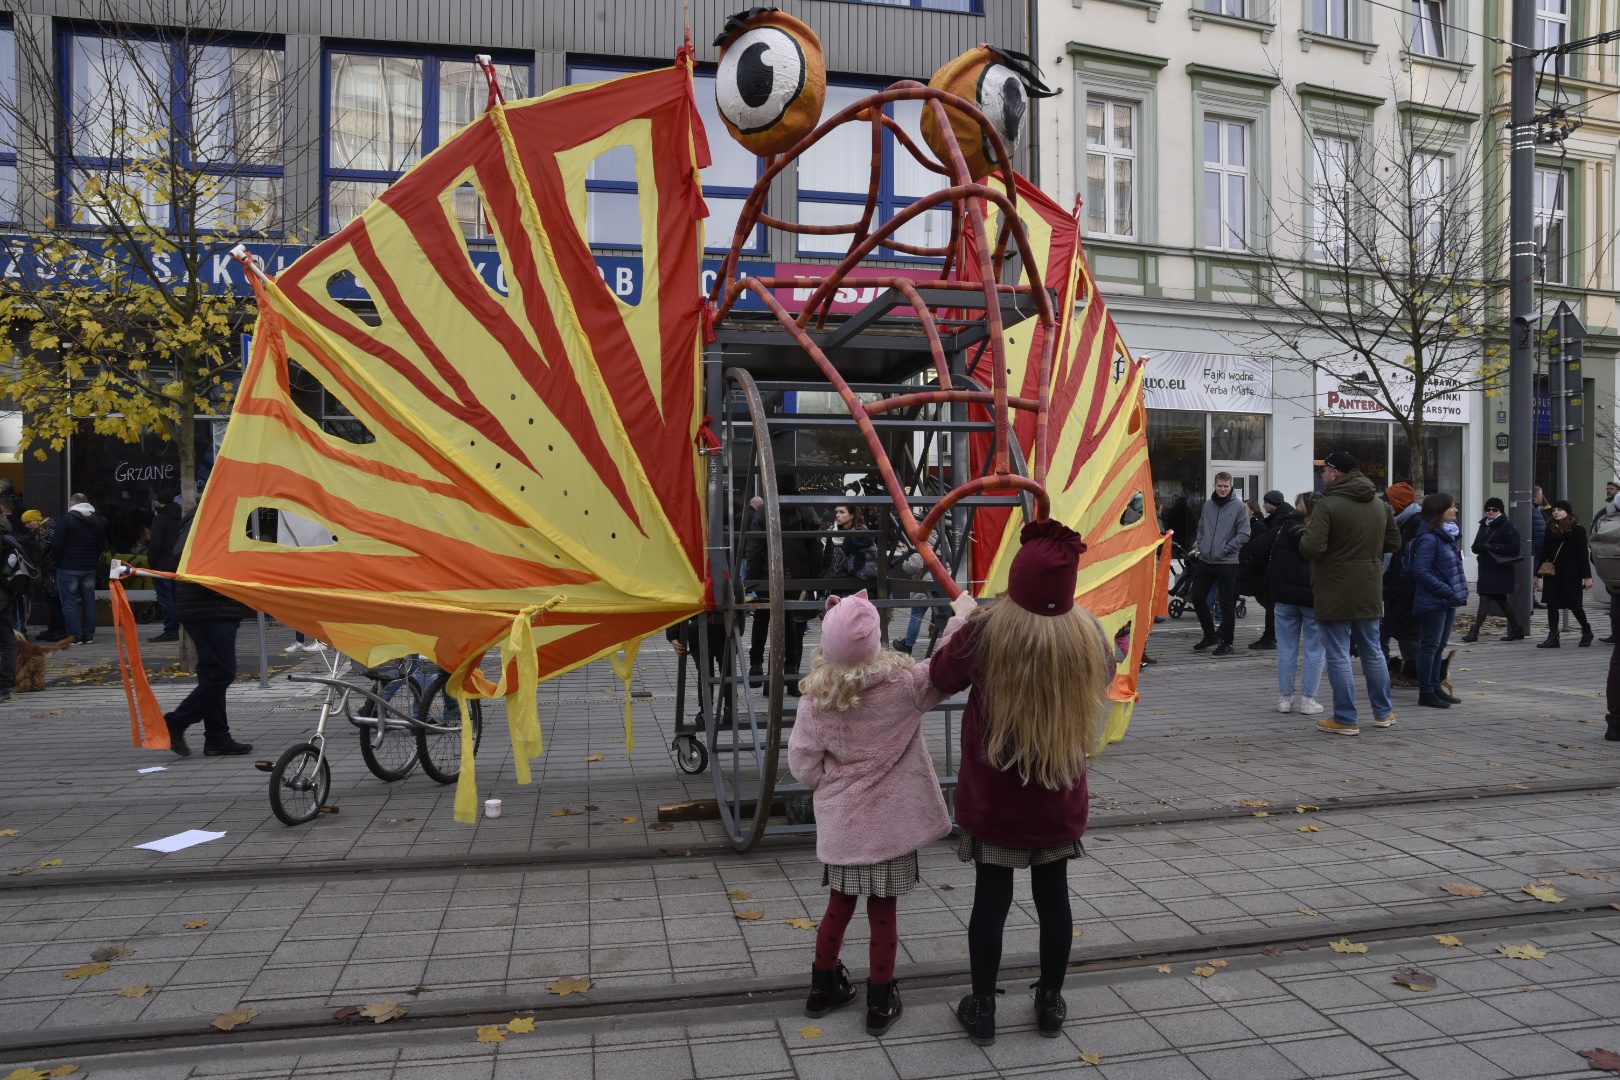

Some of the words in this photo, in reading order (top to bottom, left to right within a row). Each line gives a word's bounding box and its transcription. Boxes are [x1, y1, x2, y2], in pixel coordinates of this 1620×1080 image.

[1203, 368, 1226, 383] Fajki
[1228, 371, 1254, 381] wodne
[1203, 384, 1228, 394] Yerba
[1231, 385, 1255, 395] Mate
[1328, 391, 1385, 410] PANTERA
